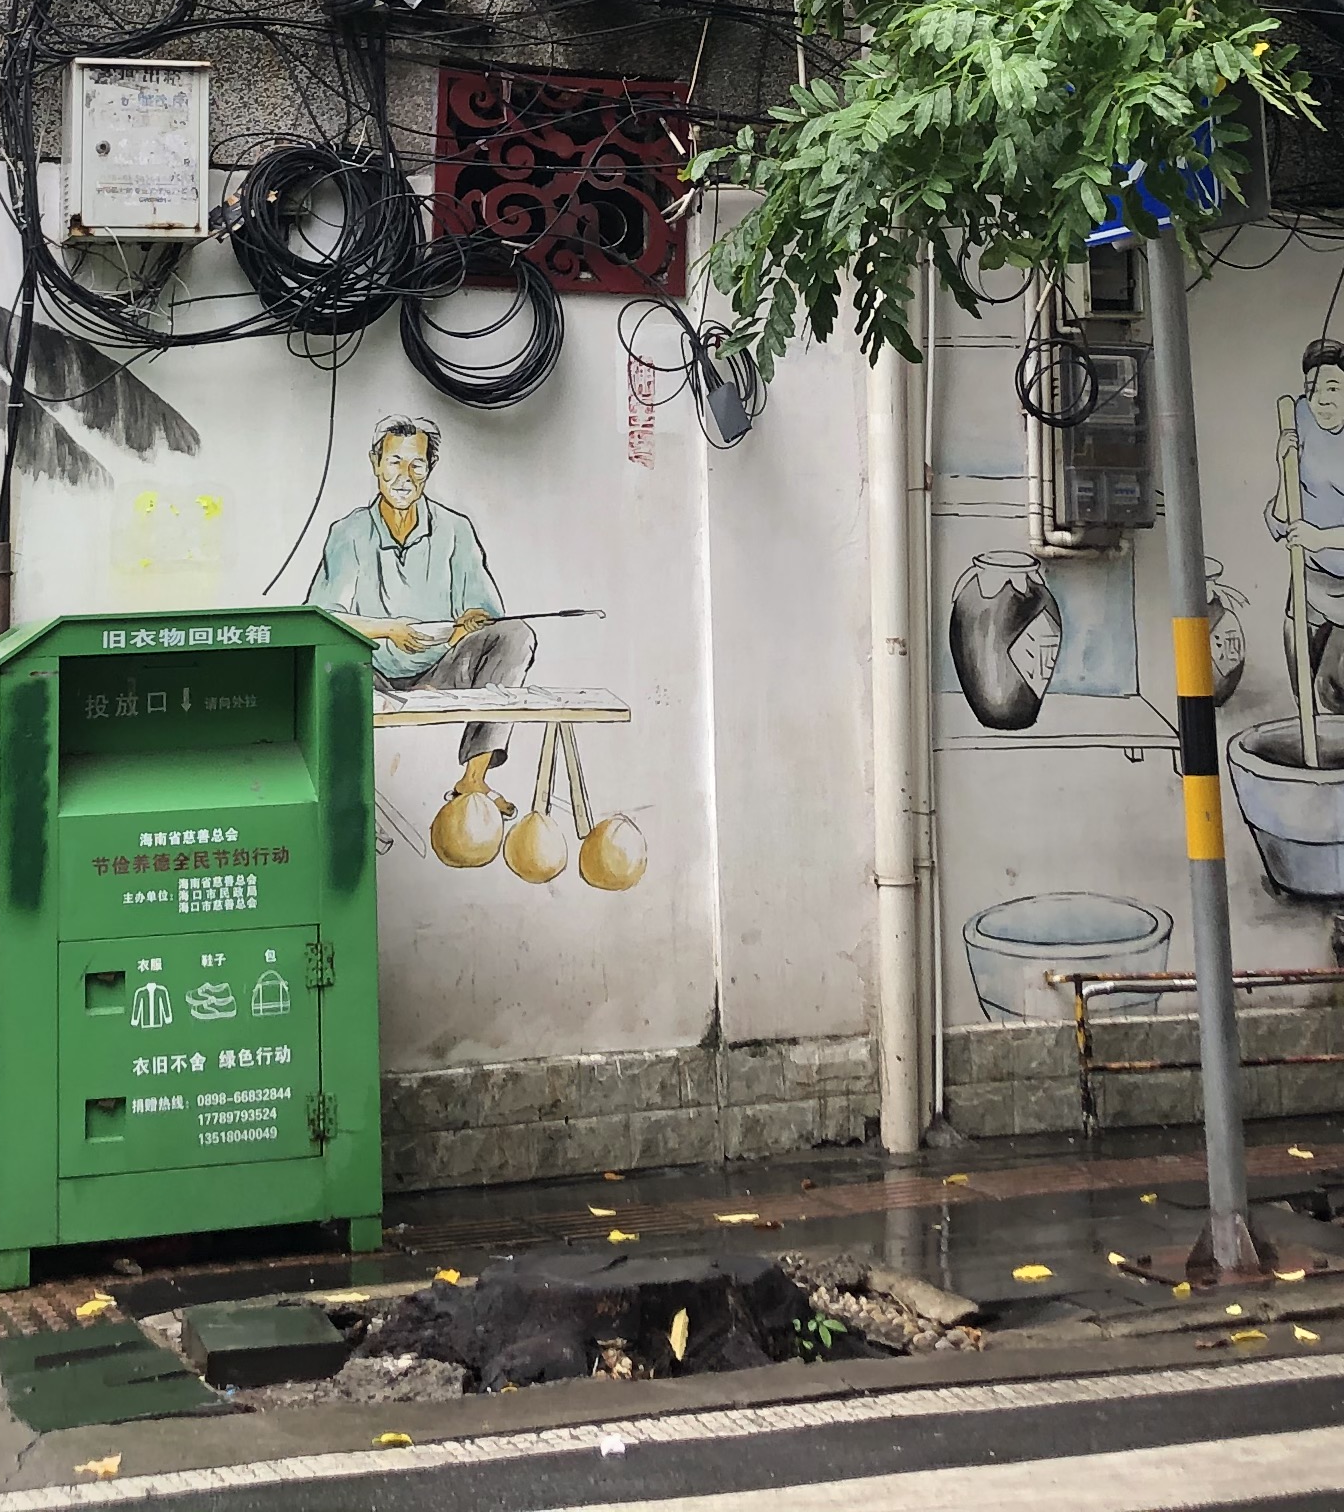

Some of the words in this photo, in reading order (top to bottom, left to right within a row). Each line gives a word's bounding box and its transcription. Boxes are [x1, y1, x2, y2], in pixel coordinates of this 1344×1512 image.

[102, 624, 272, 649] 旧衣物回收箱
[85, 691, 167, 719] 投放口
[139, 827, 239, 848] 海南省慈善总会
[92, 845, 290, 876] 节俭养德全民节约行动
[178, 873, 258, 890] 海南省慈善总会
[178, 886, 258, 902] 海口市民政局
[178, 897, 258, 914] 海口市慈善总会
[137, 957, 163, 973] 衣服
[201, 953, 227, 968] 鞋子
[264, 948, 277, 963] 包
[132, 1052, 207, 1076] 衣旧不舍
[218, 1044, 292, 1069] 绿色行动
[197, 1086, 292, 1108] 0898-66832844
[198, 1106, 278, 1127] 17789793524
[198, 1125, 279, 1146] 13518040049
